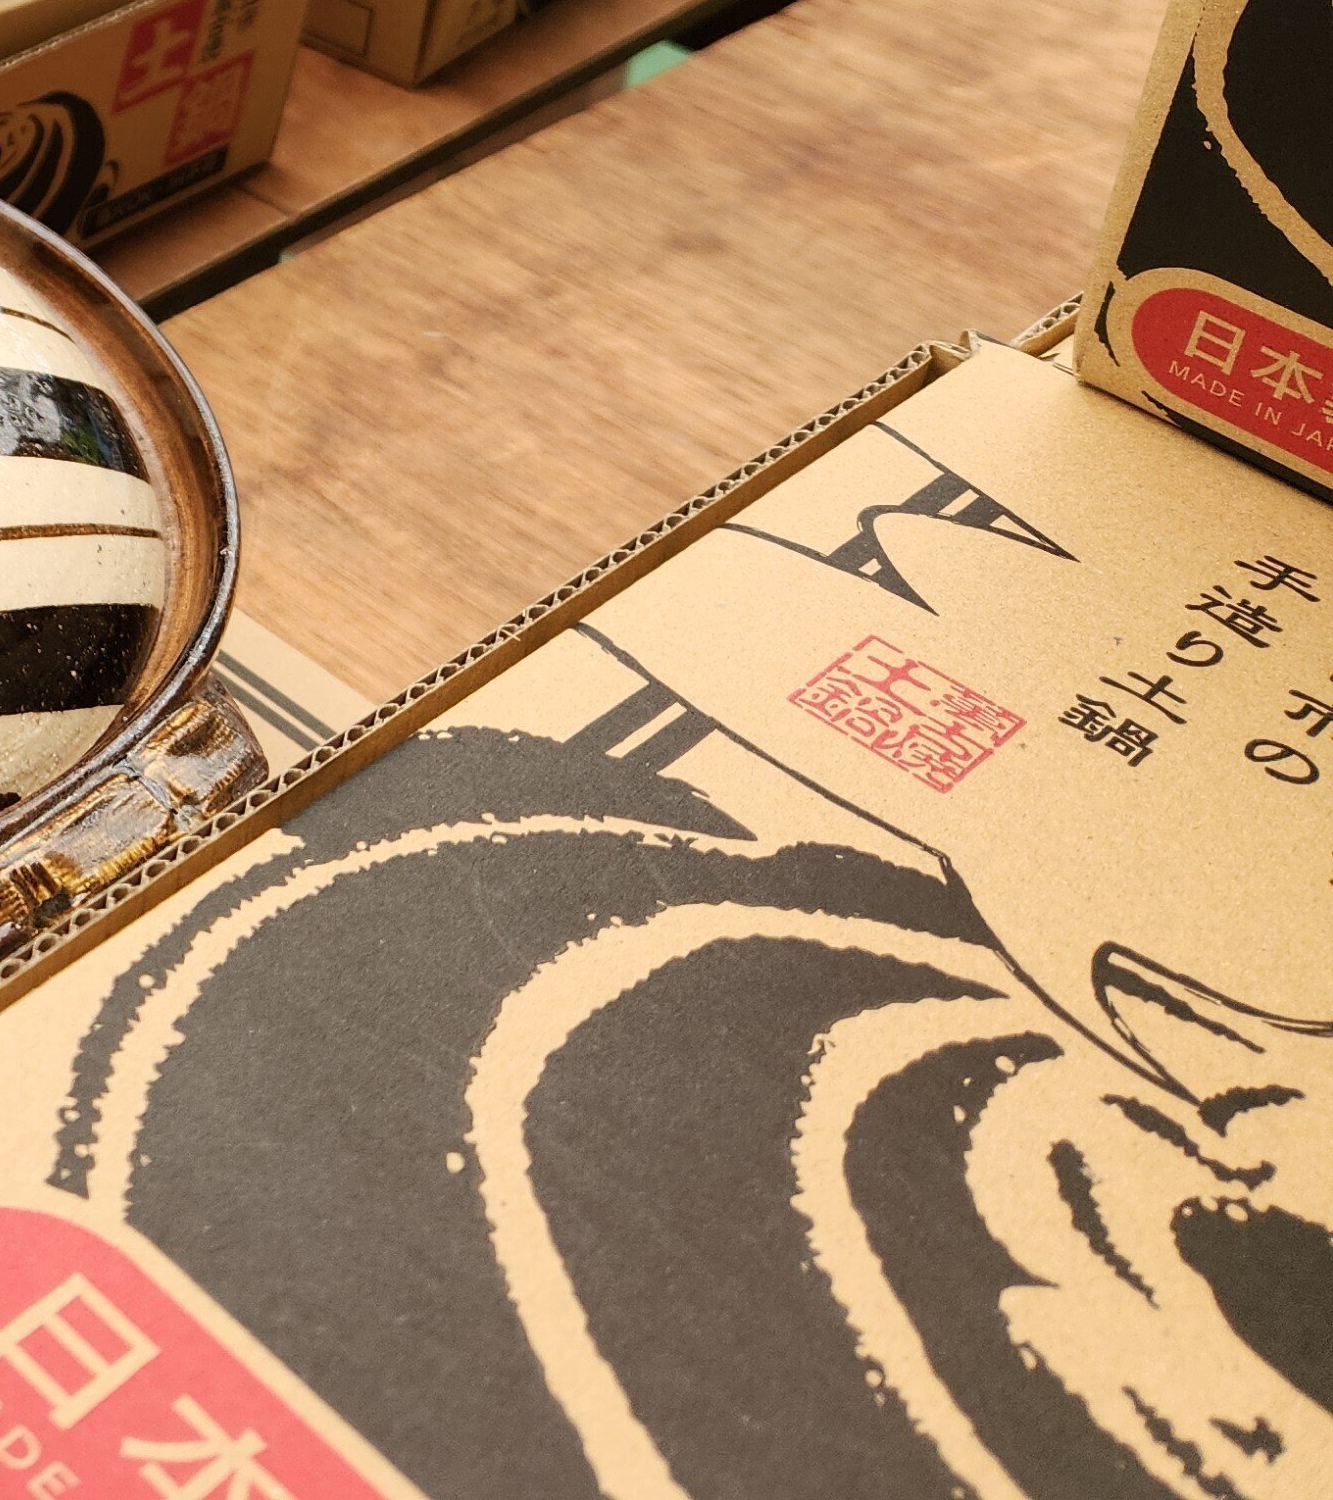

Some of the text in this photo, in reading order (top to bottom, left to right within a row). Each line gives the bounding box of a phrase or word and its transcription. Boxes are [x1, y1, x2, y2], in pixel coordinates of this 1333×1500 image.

[1169, 360, 1246, 407] MADE
[1255, 402, 1283, 426] IN
[1184, 310, 1333, 424] 日本
[1058, 555, 1321, 767] 手造り土鍋
